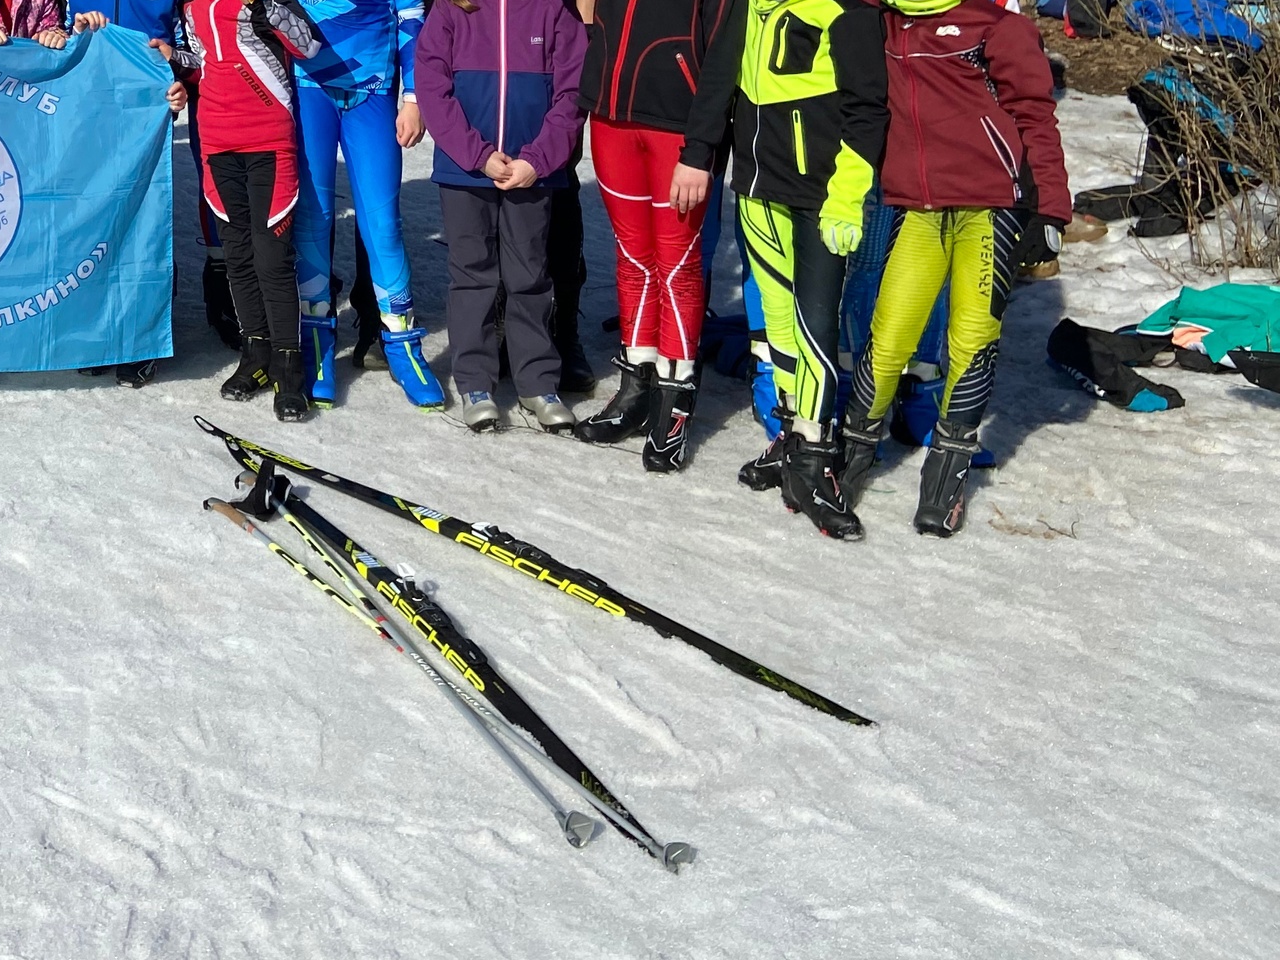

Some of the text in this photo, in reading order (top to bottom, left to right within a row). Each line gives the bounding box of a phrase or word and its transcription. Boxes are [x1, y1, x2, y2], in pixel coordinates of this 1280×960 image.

[454, 531, 627, 617] FISCHER
[376, 580, 486, 692] FISCHER
[410, 652, 447, 686] AVANTI
